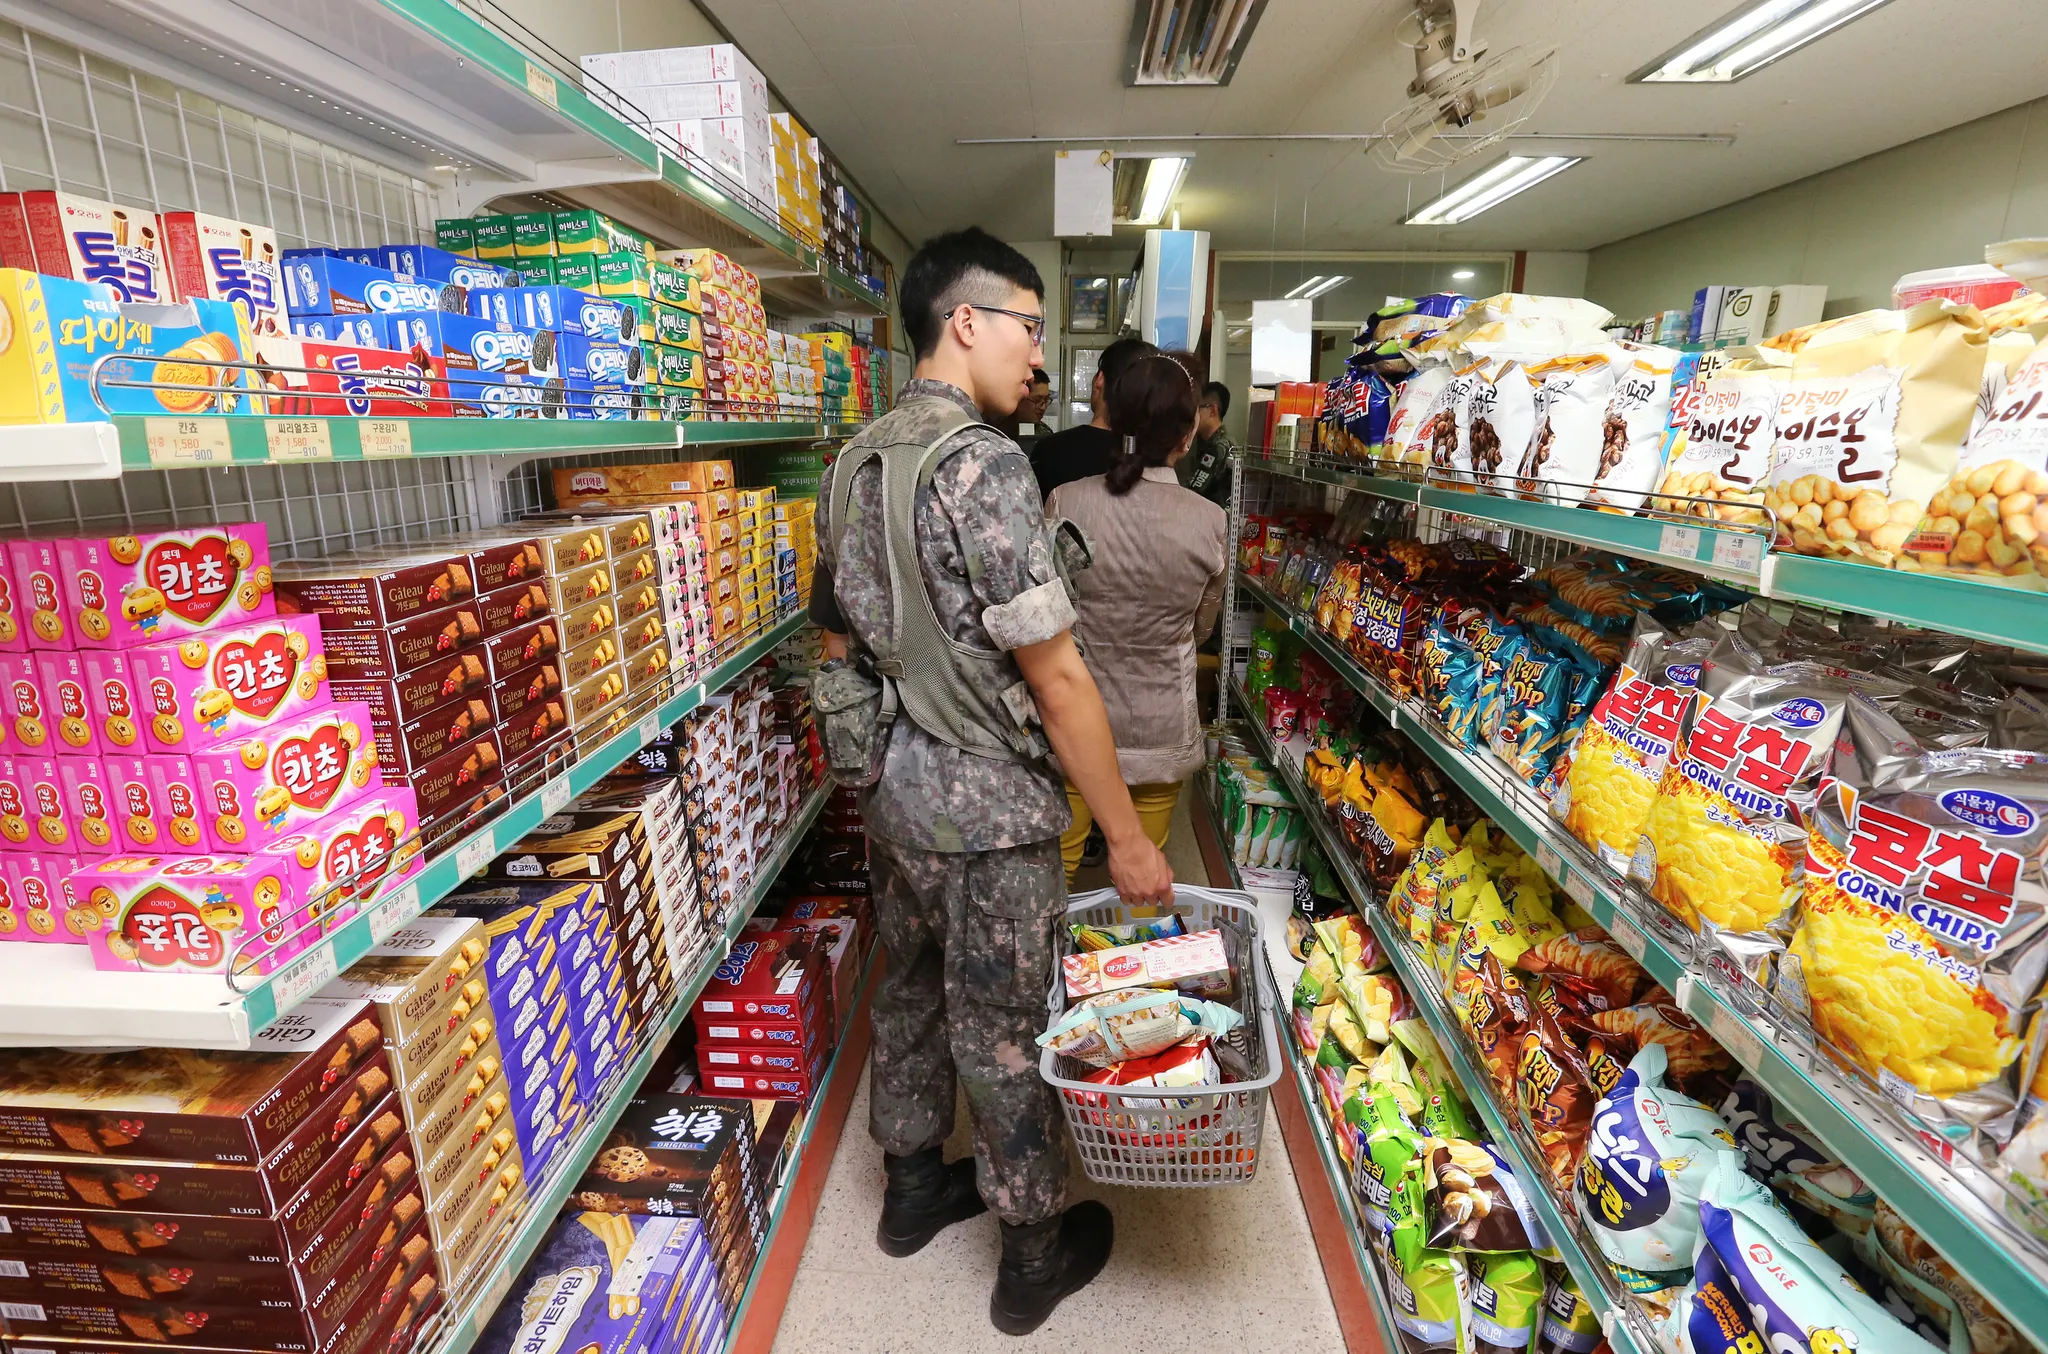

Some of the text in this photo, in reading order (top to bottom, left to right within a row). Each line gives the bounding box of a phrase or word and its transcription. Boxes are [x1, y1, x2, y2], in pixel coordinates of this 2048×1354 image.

[439, 227, 469, 239] 하비스트
[477, 224, 508, 237] 하비스트
[516, 222, 547, 234] 하비스트
[558, 218, 589, 232] 하비스트
[134, 246, 155, 265] 초코
[560, 264, 590, 277] 하비스트
[600, 260, 630, 274] 하비스트
[452, 267, 503, 290] 오레오
[657, 271, 686, 293] 하비스트
[366, 281, 438, 313] 오레오
[581, 304, 621, 337] 오레오
[661, 313, 688, 332] 하비스트
[471, 330, 533, 372] 오레오
[588, 348, 628, 381] 오레오
[663, 354, 690, 373] 하비스트
[1705, 391, 1741, 415] 인절미
[1780, 388, 1848, 414] 인절미
[178, 422, 198, 434] 칸쵸
[278, 423, 317, 434] 씨리얼초코
[173, 438, 199, 451] 1,580
[286, 437, 307, 449] 1,580
[303, 446, 317, 457] 910
[375, 437, 392, 446] 2,000
[1688, 415, 1762, 484] 라이스볼
[1776, 402, 1884, 483] 이스볼
[1797, 444, 1834, 460] 59.7%
[195, 449, 212, 460] 900
[161, 549, 181, 561] 롯데
[1735, 559, 1752, 570] 2,800
[157, 554, 227, 602] 칸쵸
[480, 562, 505, 576] Gâteau
[388, 585, 423, 602] Gâteau
[187, 600, 211, 611] Choco
[486, 604, 512, 622] Gâteau
[226, 648, 245, 660] 롯데
[399, 634, 433, 654] Gâteau
[497, 647, 522, 664] Gâteau
[224, 650, 288, 700] 칸쵸
[252, 695, 274, 707] Choco
[404, 680, 439, 702] Gâteau
[502, 687, 525, 706] Gâteau
[1511, 681, 1546, 708] Dip
[1801, 705, 1821, 722] Ca
[413, 729, 446, 751] Gâteau
[505, 725, 529, 746] Gâteau
[284, 745, 300, 757] 롯데
[1686, 704, 1812, 796] 콘칩
[281, 742, 341, 793] 칸쵸
[309, 786, 329, 800] Choco
[421, 772, 453, 797] Gâteau
[1680, 758, 1788, 819] CORN CHIPS
[1953, 792, 1996, 813] 식물성
[1705, 804, 1777, 843] 군옥수수맛
[1951, 805, 1998, 826] 해조칼슘
[1998, 804, 2029, 826] Ca
[1845, 803, 2020, 922] 콘칩
[1837, 870, 1999, 953] CORN CHIPS
[134, 913, 211, 951] 칸쵸
[1886, 929, 1978, 986] 군옥수수맛
[292, 971, 313, 992] 2,880
[309, 969, 329, 988] 1,770
[254, 1089, 281, 1116] LOTTE
[1526, 1078, 1567, 1126] Dip
[651, 1108, 722, 1143] 칙촉
[1653, 1117, 1672, 1137] J&E
[216, 1153, 248, 1162] LOTTE
[268, 1142, 294, 1170] LOTTE
[1362, 1154, 1386, 1180] 농심
[230, 1206, 261, 1215] LOTTE
[285, 1189, 310, 1219] LOTTE
[299, 1233, 324, 1264] LOTTE
[310, 1223, 354, 1276] Gâteau
[1766, 1265, 1799, 1291] J&E
[1918, 1259, 1936, 1277] 100
[312, 1277, 337, 1309] LOTTE
[322, 1265, 365, 1319] Gâteau
[260, 1299, 292, 1308] LOTTE
[1703, 1281, 1747, 1335] KERNELS
[1696, 1290, 1736, 1342] POPCORN
[275, 1342, 305, 1351] LOTTE
[322, 1322, 347, 1354] LOTTE
